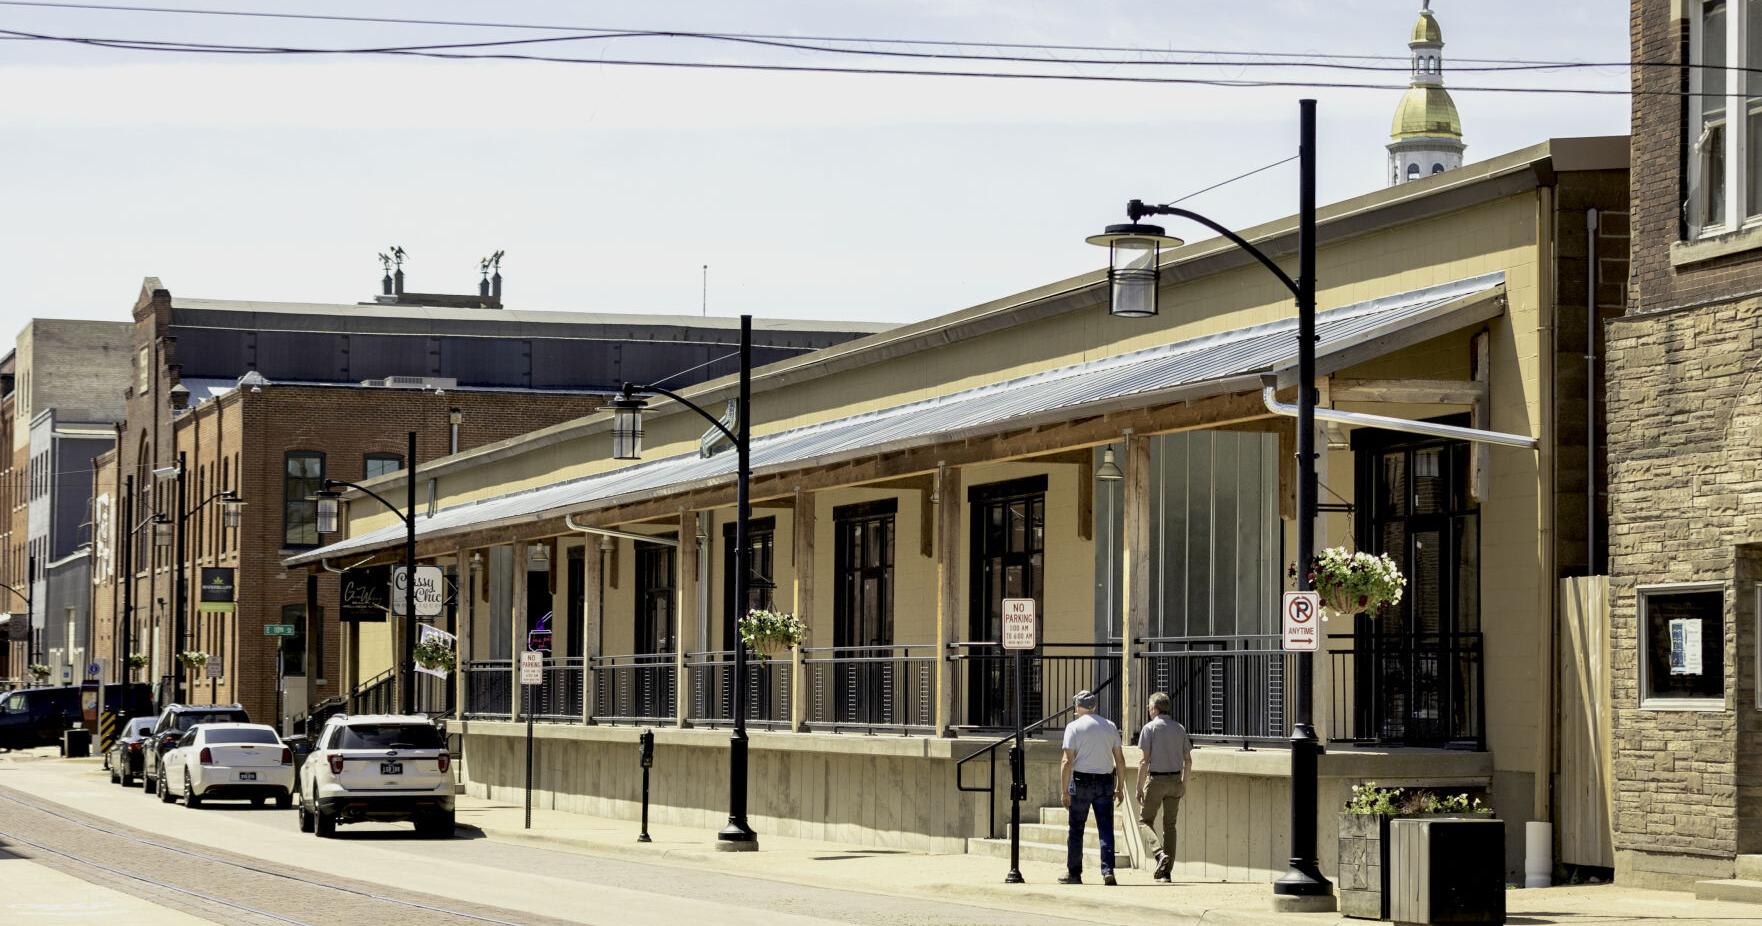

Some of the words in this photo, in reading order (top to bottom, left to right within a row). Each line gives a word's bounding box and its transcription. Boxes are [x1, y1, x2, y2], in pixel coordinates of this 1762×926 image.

[396, 572, 435, 592] Cssy
[1013, 603, 1025, 613] NO
[1005, 614, 1033, 624] PARKING
[1021, 624, 1029, 632] AM
[1289, 627, 1314, 635] ANYTIME
[1025, 632, 1033, 640] AM
